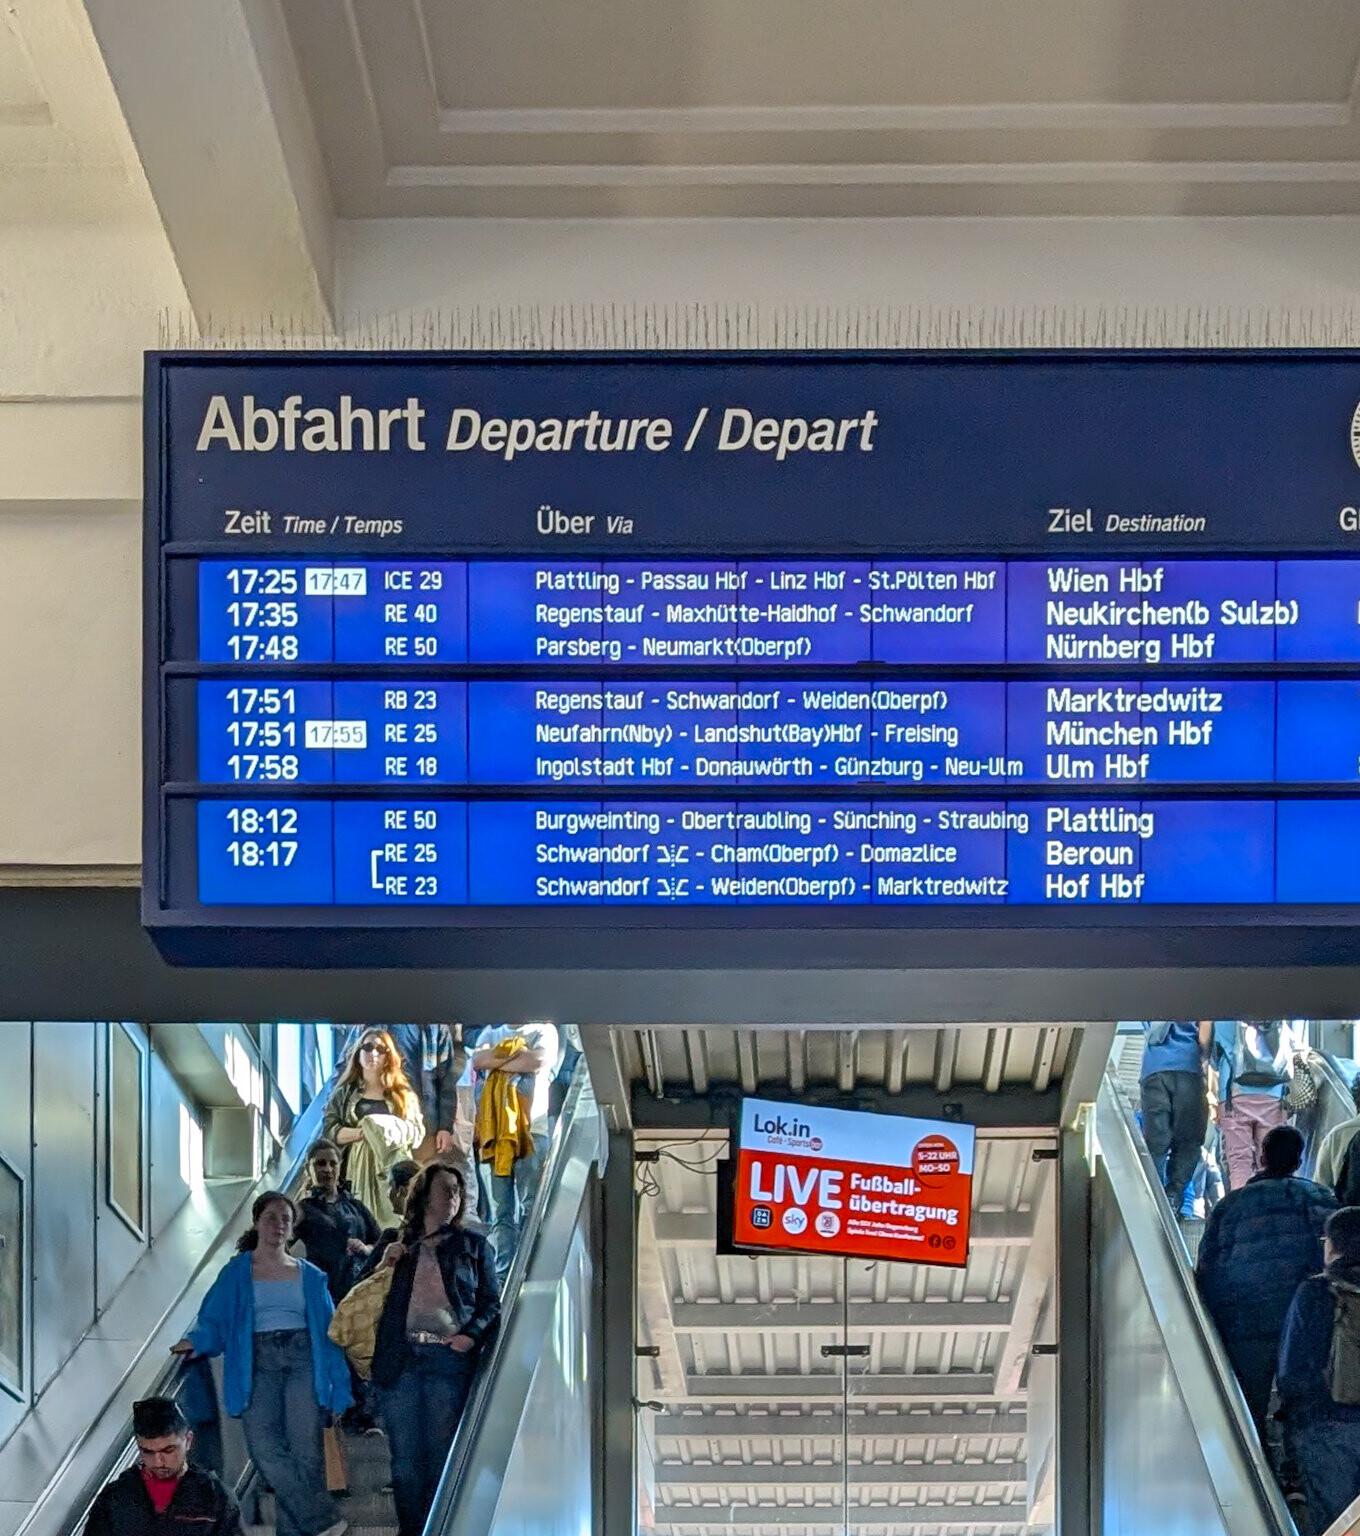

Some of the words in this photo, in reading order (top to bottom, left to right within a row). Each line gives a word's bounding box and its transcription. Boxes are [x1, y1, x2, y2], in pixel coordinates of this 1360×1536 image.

[196, 396, 425, 451] Abfahrt
[446, 409, 672, 460] Departure
[717, 409, 878, 460] Depart
[225, 510, 271, 534] Zeit
[283, 515, 326, 534] Time
[343, 515, 403, 538] Temps
[537, 504, 595, 534] Über
[607, 515, 634, 534] Via
[1048, 508, 1093, 533] Ziel
[1105, 513, 1205, 532] Destination
[227, 569, 297, 594] 17:25
[309, 572, 364, 592] 17:47
[385, 571, 412, 590] ICE
[420, 571, 442, 590] 29
[536, 571, 619, 594] Plattling
[642, 571, 708, 590] Passau
[716, 571, 748, 590] Hbf
[771, 571, 806, 590] Linz
[815, 571, 845, 590] Hbf
[869, 571, 957, 590] St.Pölten
[964, 571, 996, 590] Hbf
[1048, 568, 1108, 592] Wien
[1120, 567, 1163, 592] Hbf
[227, 602, 297, 627] 17:35
[385, 604, 407, 622] RE
[414, 604, 437, 622] 40
[536, 604, 644, 627] Regenstauf
[667, 604, 837, 623] Maxhütte-Haidhof
[860, 604, 973, 623] Schwandorf
[1047, 600, 1209, 625] Neukirchen(b
[1220, 600, 1298, 624] Sulzb)
[227, 635, 297, 660] 17:48
[385, 637, 407, 656] RE
[414, 637, 437, 656] 50
[536, 637, 620, 661] Parsberg
[643, 637, 812, 660] Neumarkt(Oberpf)
[1047, 634, 1160, 662] Nürnberg
[1172, 633, 1215, 658] Hbf
[227, 689, 295, 714] 17:51
[385, 691, 407, 709] RB
[414, 691, 437, 710] 23
[536, 691, 644, 714] Regenstauf
[667, 691, 780, 710] Schwandorf
[803, 691, 948, 714] Weiden(Oberpf)
[1047, 687, 1223, 713] Marktredwitz
[227, 722, 295, 747] 17:51
[309, 725, 364, 744] 17:55
[385, 724, 407, 743] RE
[414, 724, 437, 743] 25
[536, 724, 672, 747] Neufahrn(Nby)
[694, 724, 862, 747] Landshut(Bay)Hbf
[885, 724, 958, 747] Freising
[1047, 721, 1158, 746] München
[1169, 720, 1213, 745] Hbf
[227, 755, 298, 780] 17:58
[385, 757, 407, 776] RE
[416, 757, 437, 776] 18
[536, 757, 634, 781] Ingolstadt
[642, 757, 673, 776] Hbf
[696, 757, 812, 776] Donauwörth
[834, 757, 923, 781] Günzburg
[945, 757, 1023, 776] Neu-Ulm
[1047, 754, 1094, 778] Ulm
[1105, 753, 1149, 778] Hbf
[227, 809, 297, 834] 18:12
[385, 810, 407, 829] RE
[414, 810, 437, 829] 50
[536, 811, 660, 834] Burgweinting
[682, 811, 811, 834] Obertraubling
[833, 811, 916, 834] Sünching
[938, 811, 1029, 834] Straubing
[1047, 807, 1154, 836] Plattling
[227, 842, 297, 867] 18:17
[385, 844, 407, 863] RE
[414, 844, 437, 863] 25
[536, 844, 650, 863] Schwandorf
[711, 844, 839, 867] Cham(Oberpf)
[861, 844, 956, 863] Domazlice
[1047, 840, 1133, 866] Beroun
[385, 877, 407, 896] RE
[414, 877, 437, 896] 23
[536, 877, 650, 896] Schwandorf
[711, 877, 855, 900] Weiden(Oberpf)
[878, 877, 1009, 896] Marktredwitz
[1046, 873, 1089, 898] Hof
[1100, 873, 1145, 898] Hbf
[754, 1113, 810, 1138] Lok.in
[750, 1161, 844, 1210] LIVE
[850, 1173, 922, 1195] Fußball-
[784, 1214, 805, 1227] sky
[848, 1195, 959, 1226] übertragung
